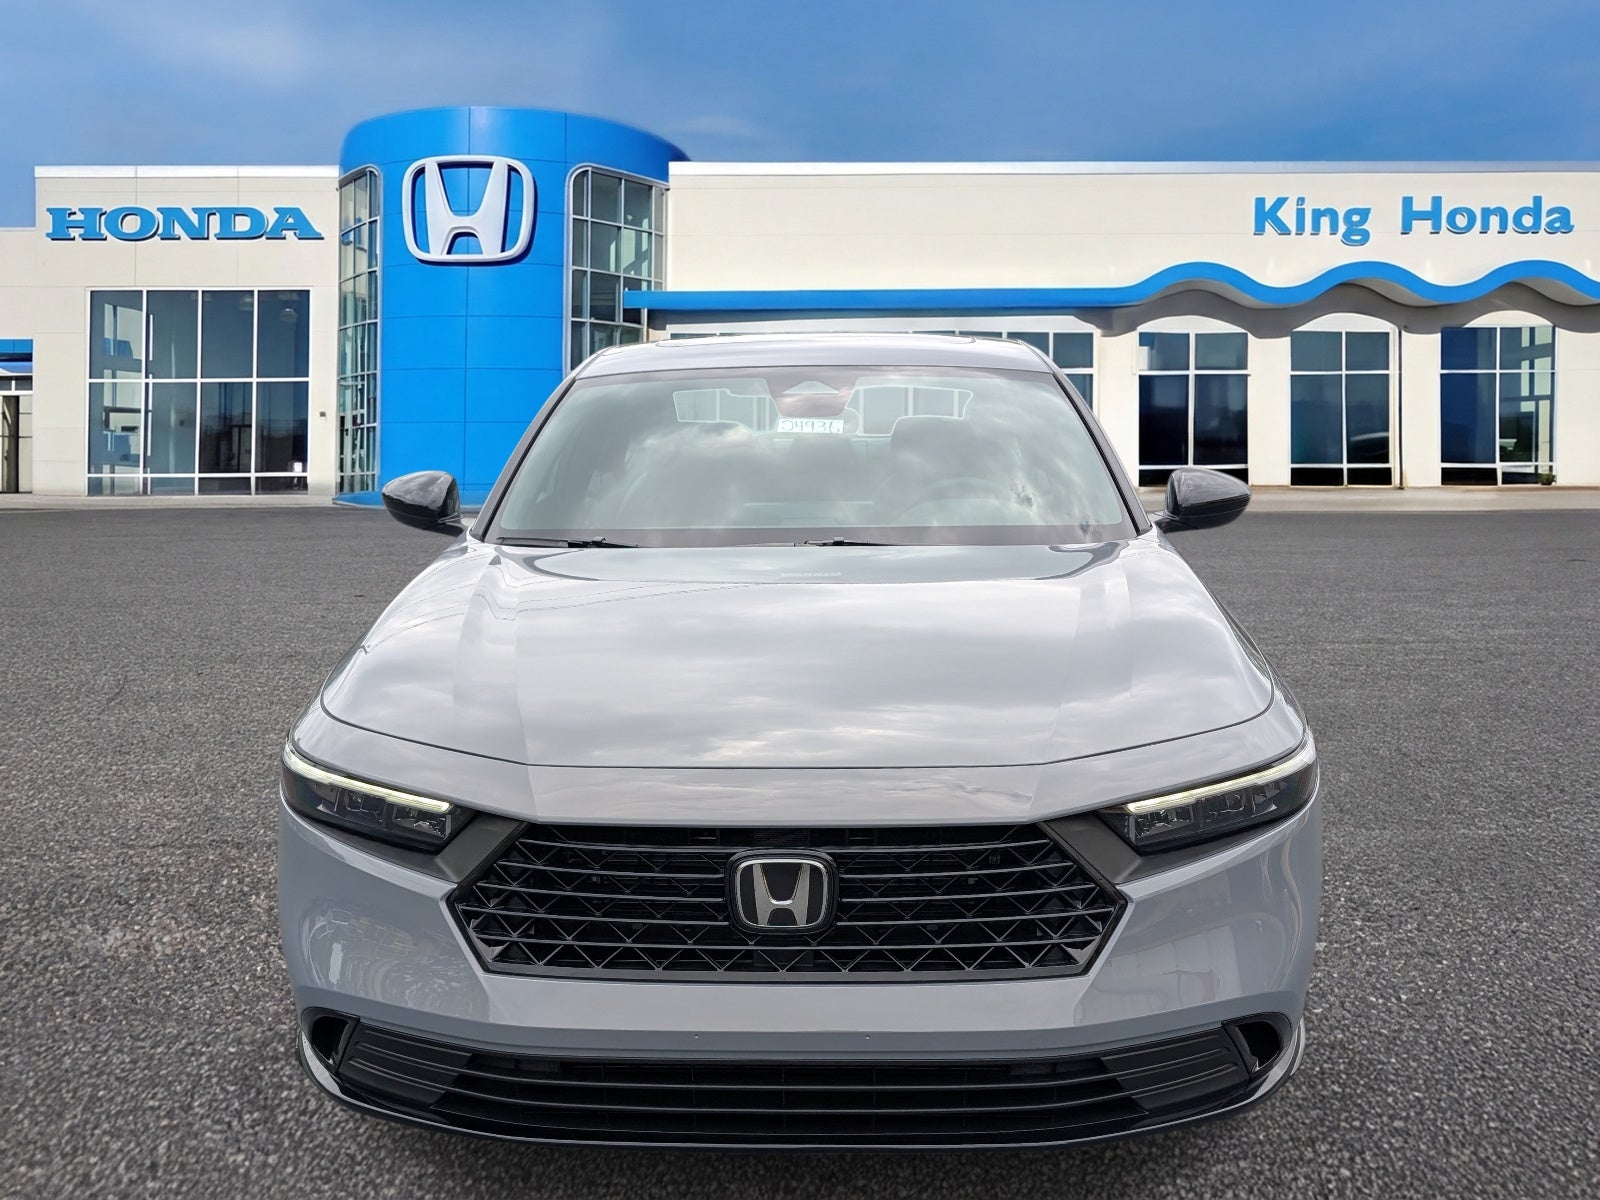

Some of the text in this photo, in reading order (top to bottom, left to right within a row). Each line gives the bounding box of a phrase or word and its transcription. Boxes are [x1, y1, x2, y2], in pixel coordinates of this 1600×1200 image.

[45, 206, 325, 241] HONDA
[1253, 195, 1575, 246] King Honda
